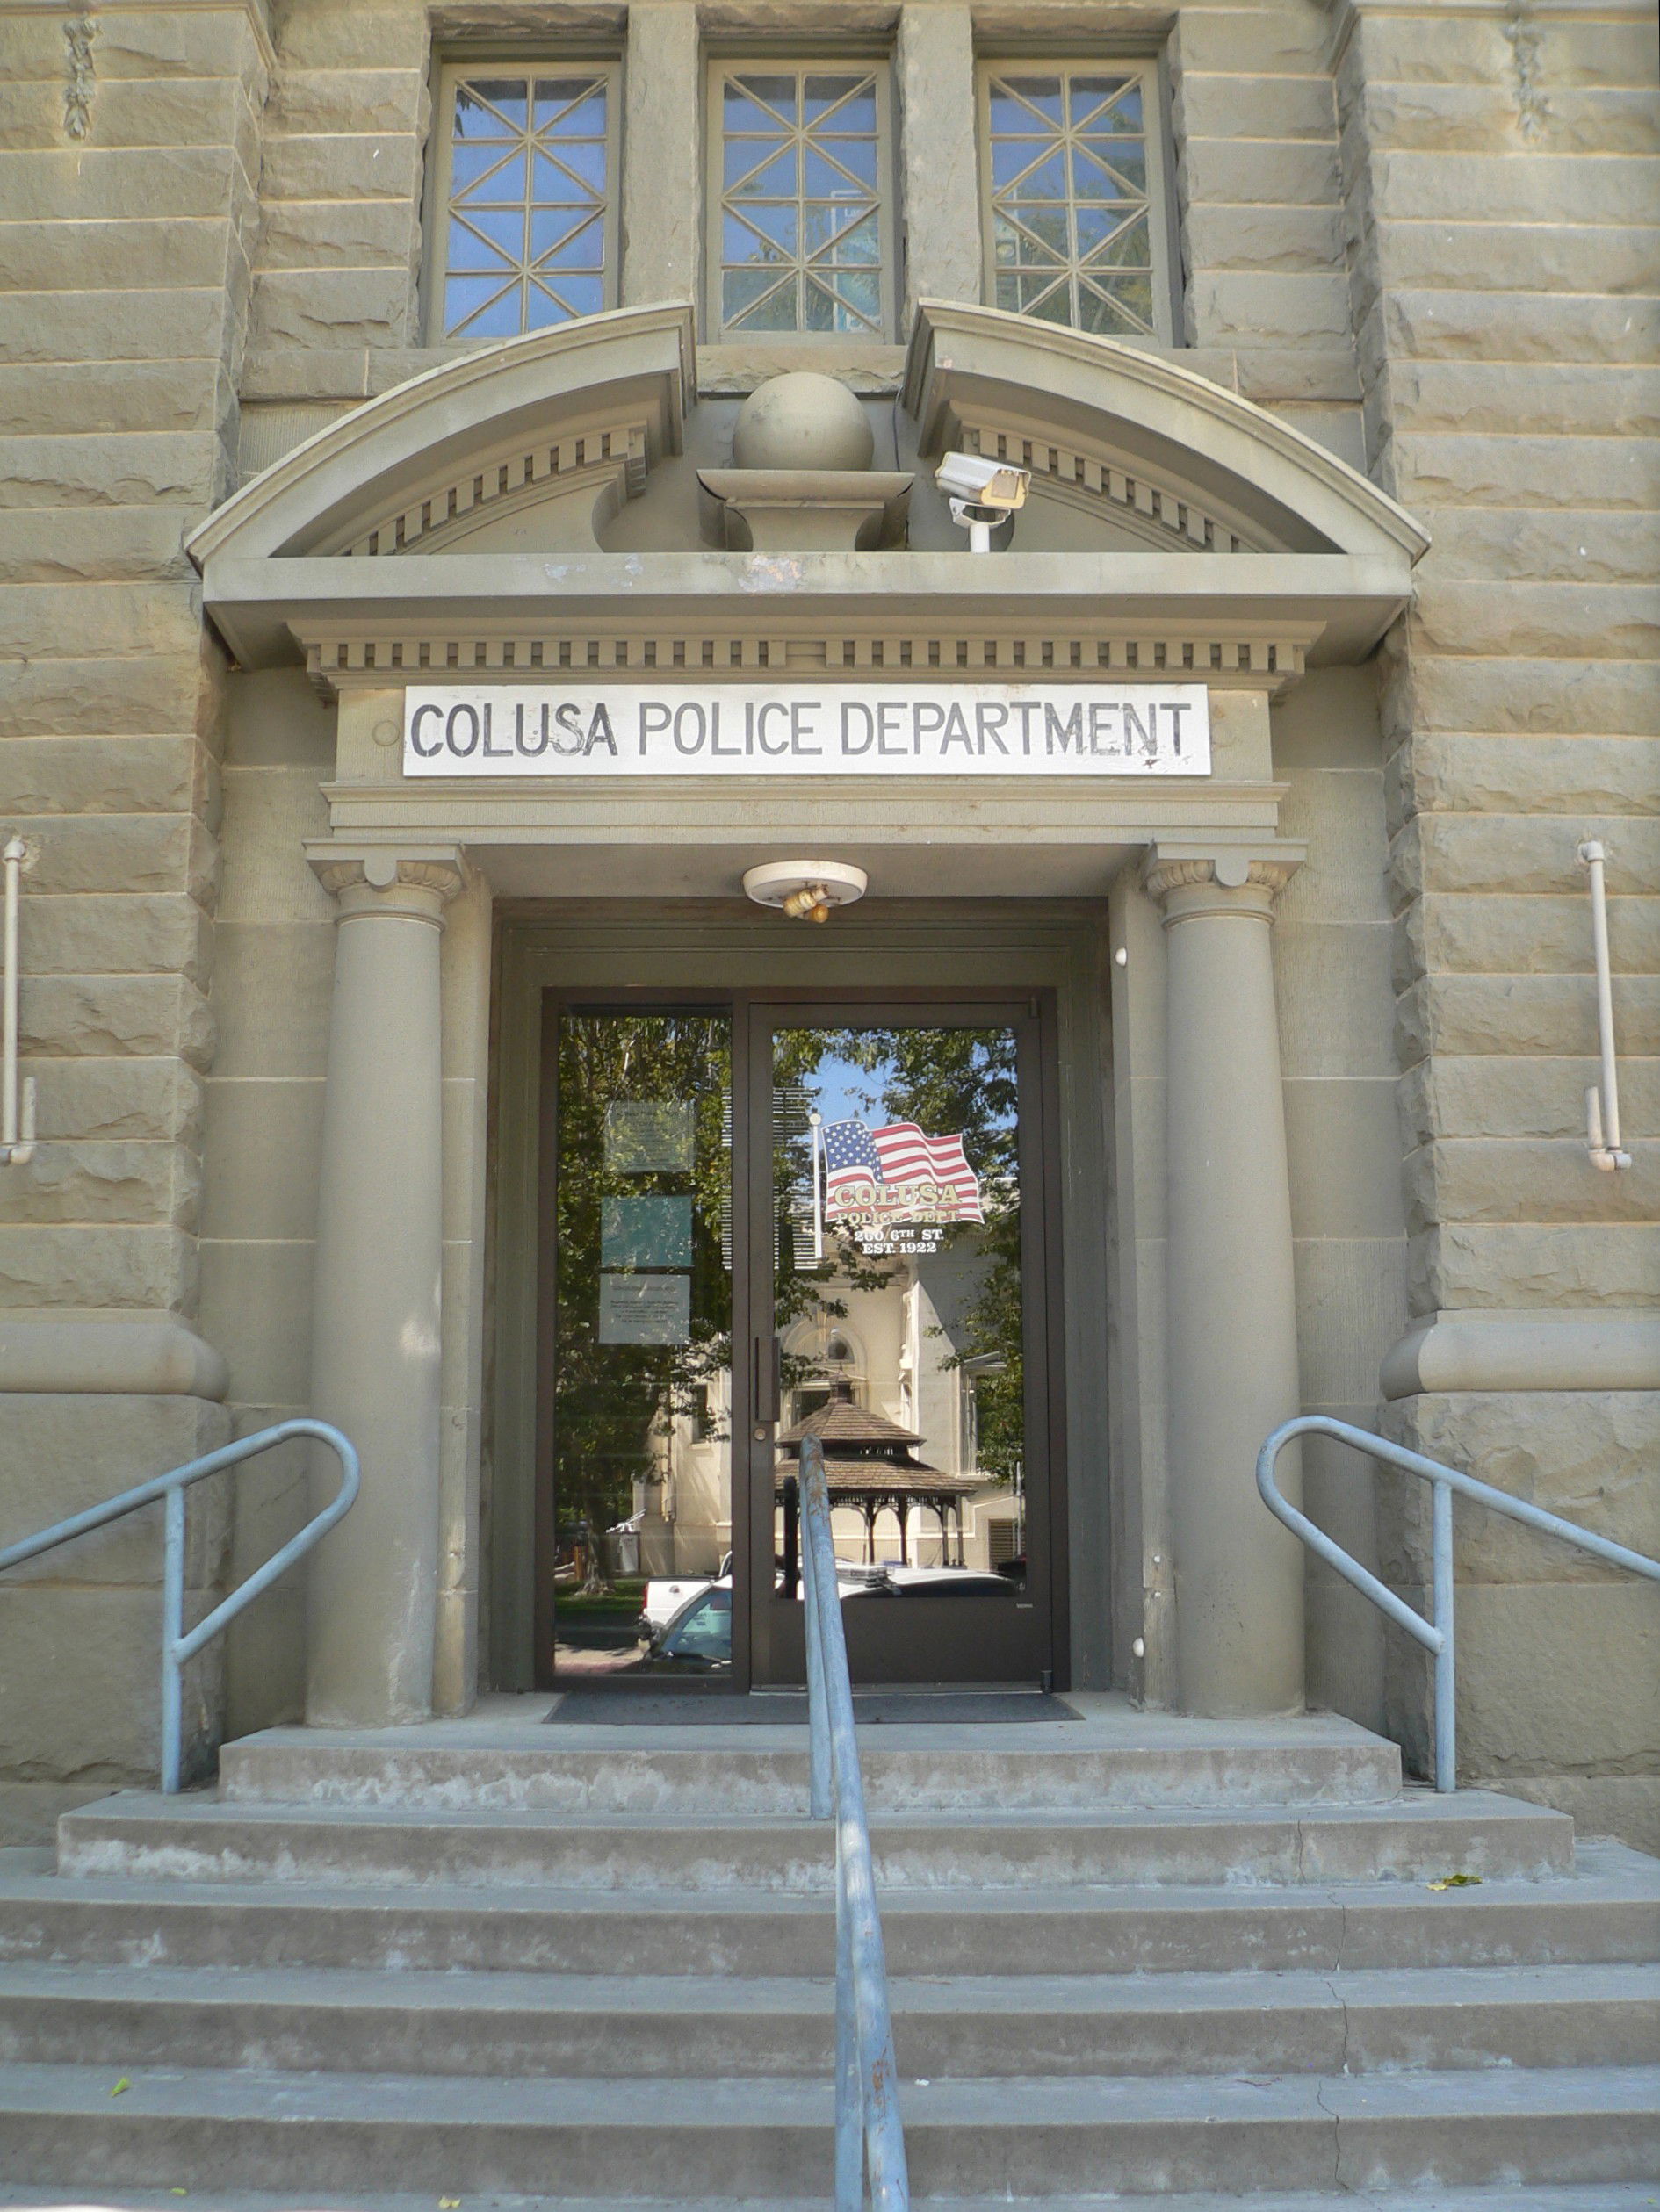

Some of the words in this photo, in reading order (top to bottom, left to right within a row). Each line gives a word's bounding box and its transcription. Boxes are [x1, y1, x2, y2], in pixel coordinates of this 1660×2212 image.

[410, 703, 618, 758] COLUSA
[639, 702, 823, 756] POLICE
[840, 702, 1192, 756] DEPARTMENT
[834, 1182, 961, 1207] COLUSA
[836, 1211, 905, 1225] POLICE
[890, 1229, 915, 1242] 6TH
[921, 1228, 945, 1241] ST.
[862, 1243, 896, 1255] EST.
[899, 1242, 937, 1254] 1922
